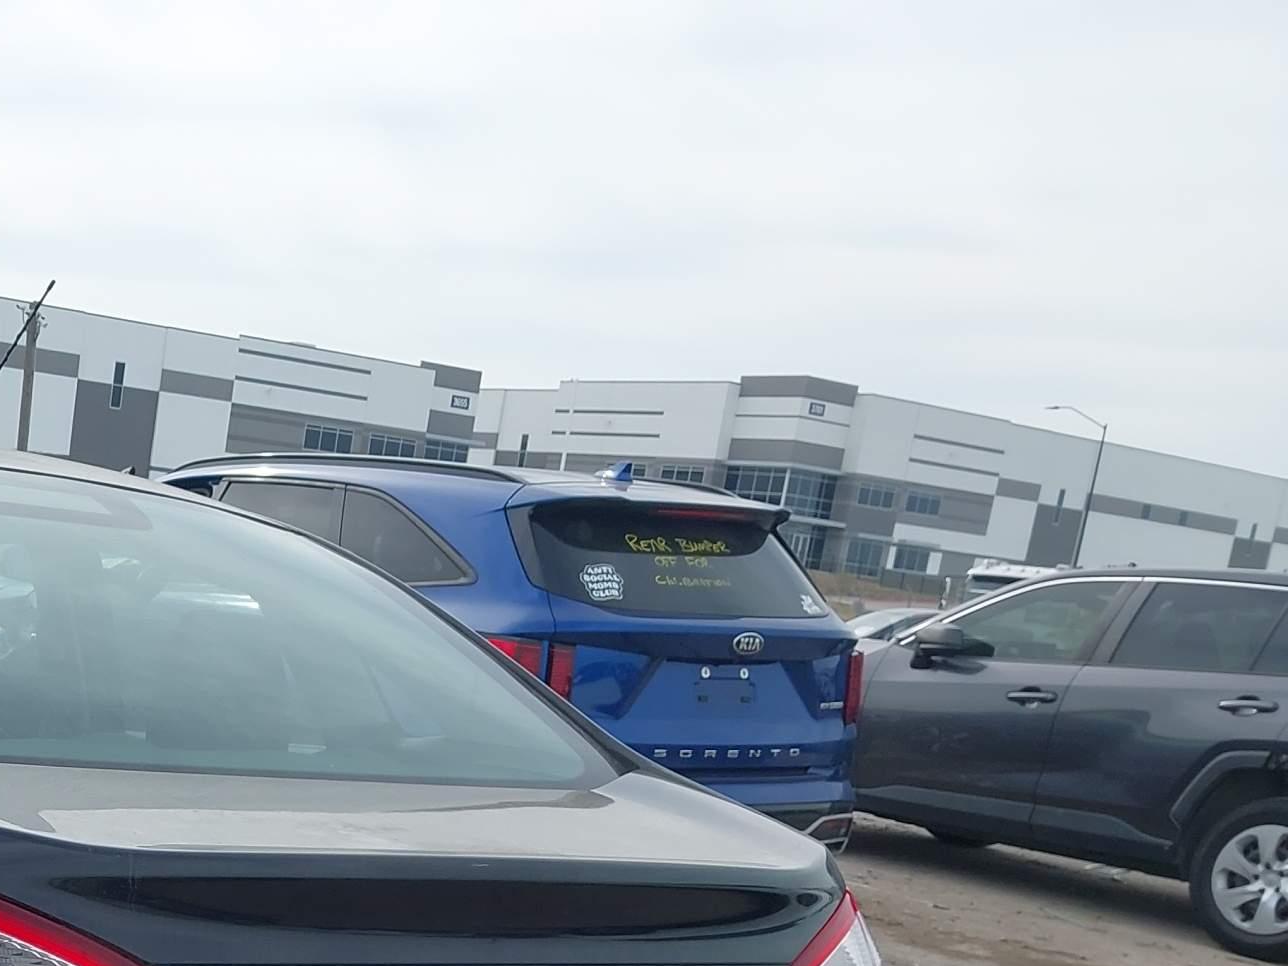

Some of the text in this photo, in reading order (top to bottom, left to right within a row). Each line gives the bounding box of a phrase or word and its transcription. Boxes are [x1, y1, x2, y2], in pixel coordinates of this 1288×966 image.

[625, 534, 730, 553] REAR BUMPER
[587, 566, 613, 574] ANTI
[583, 573, 620, 582] SOCIAL
[592, 589, 619, 597] CLUB
[738, 637, 762, 651] KIA
[653, 748, 800, 758] SORENTO
